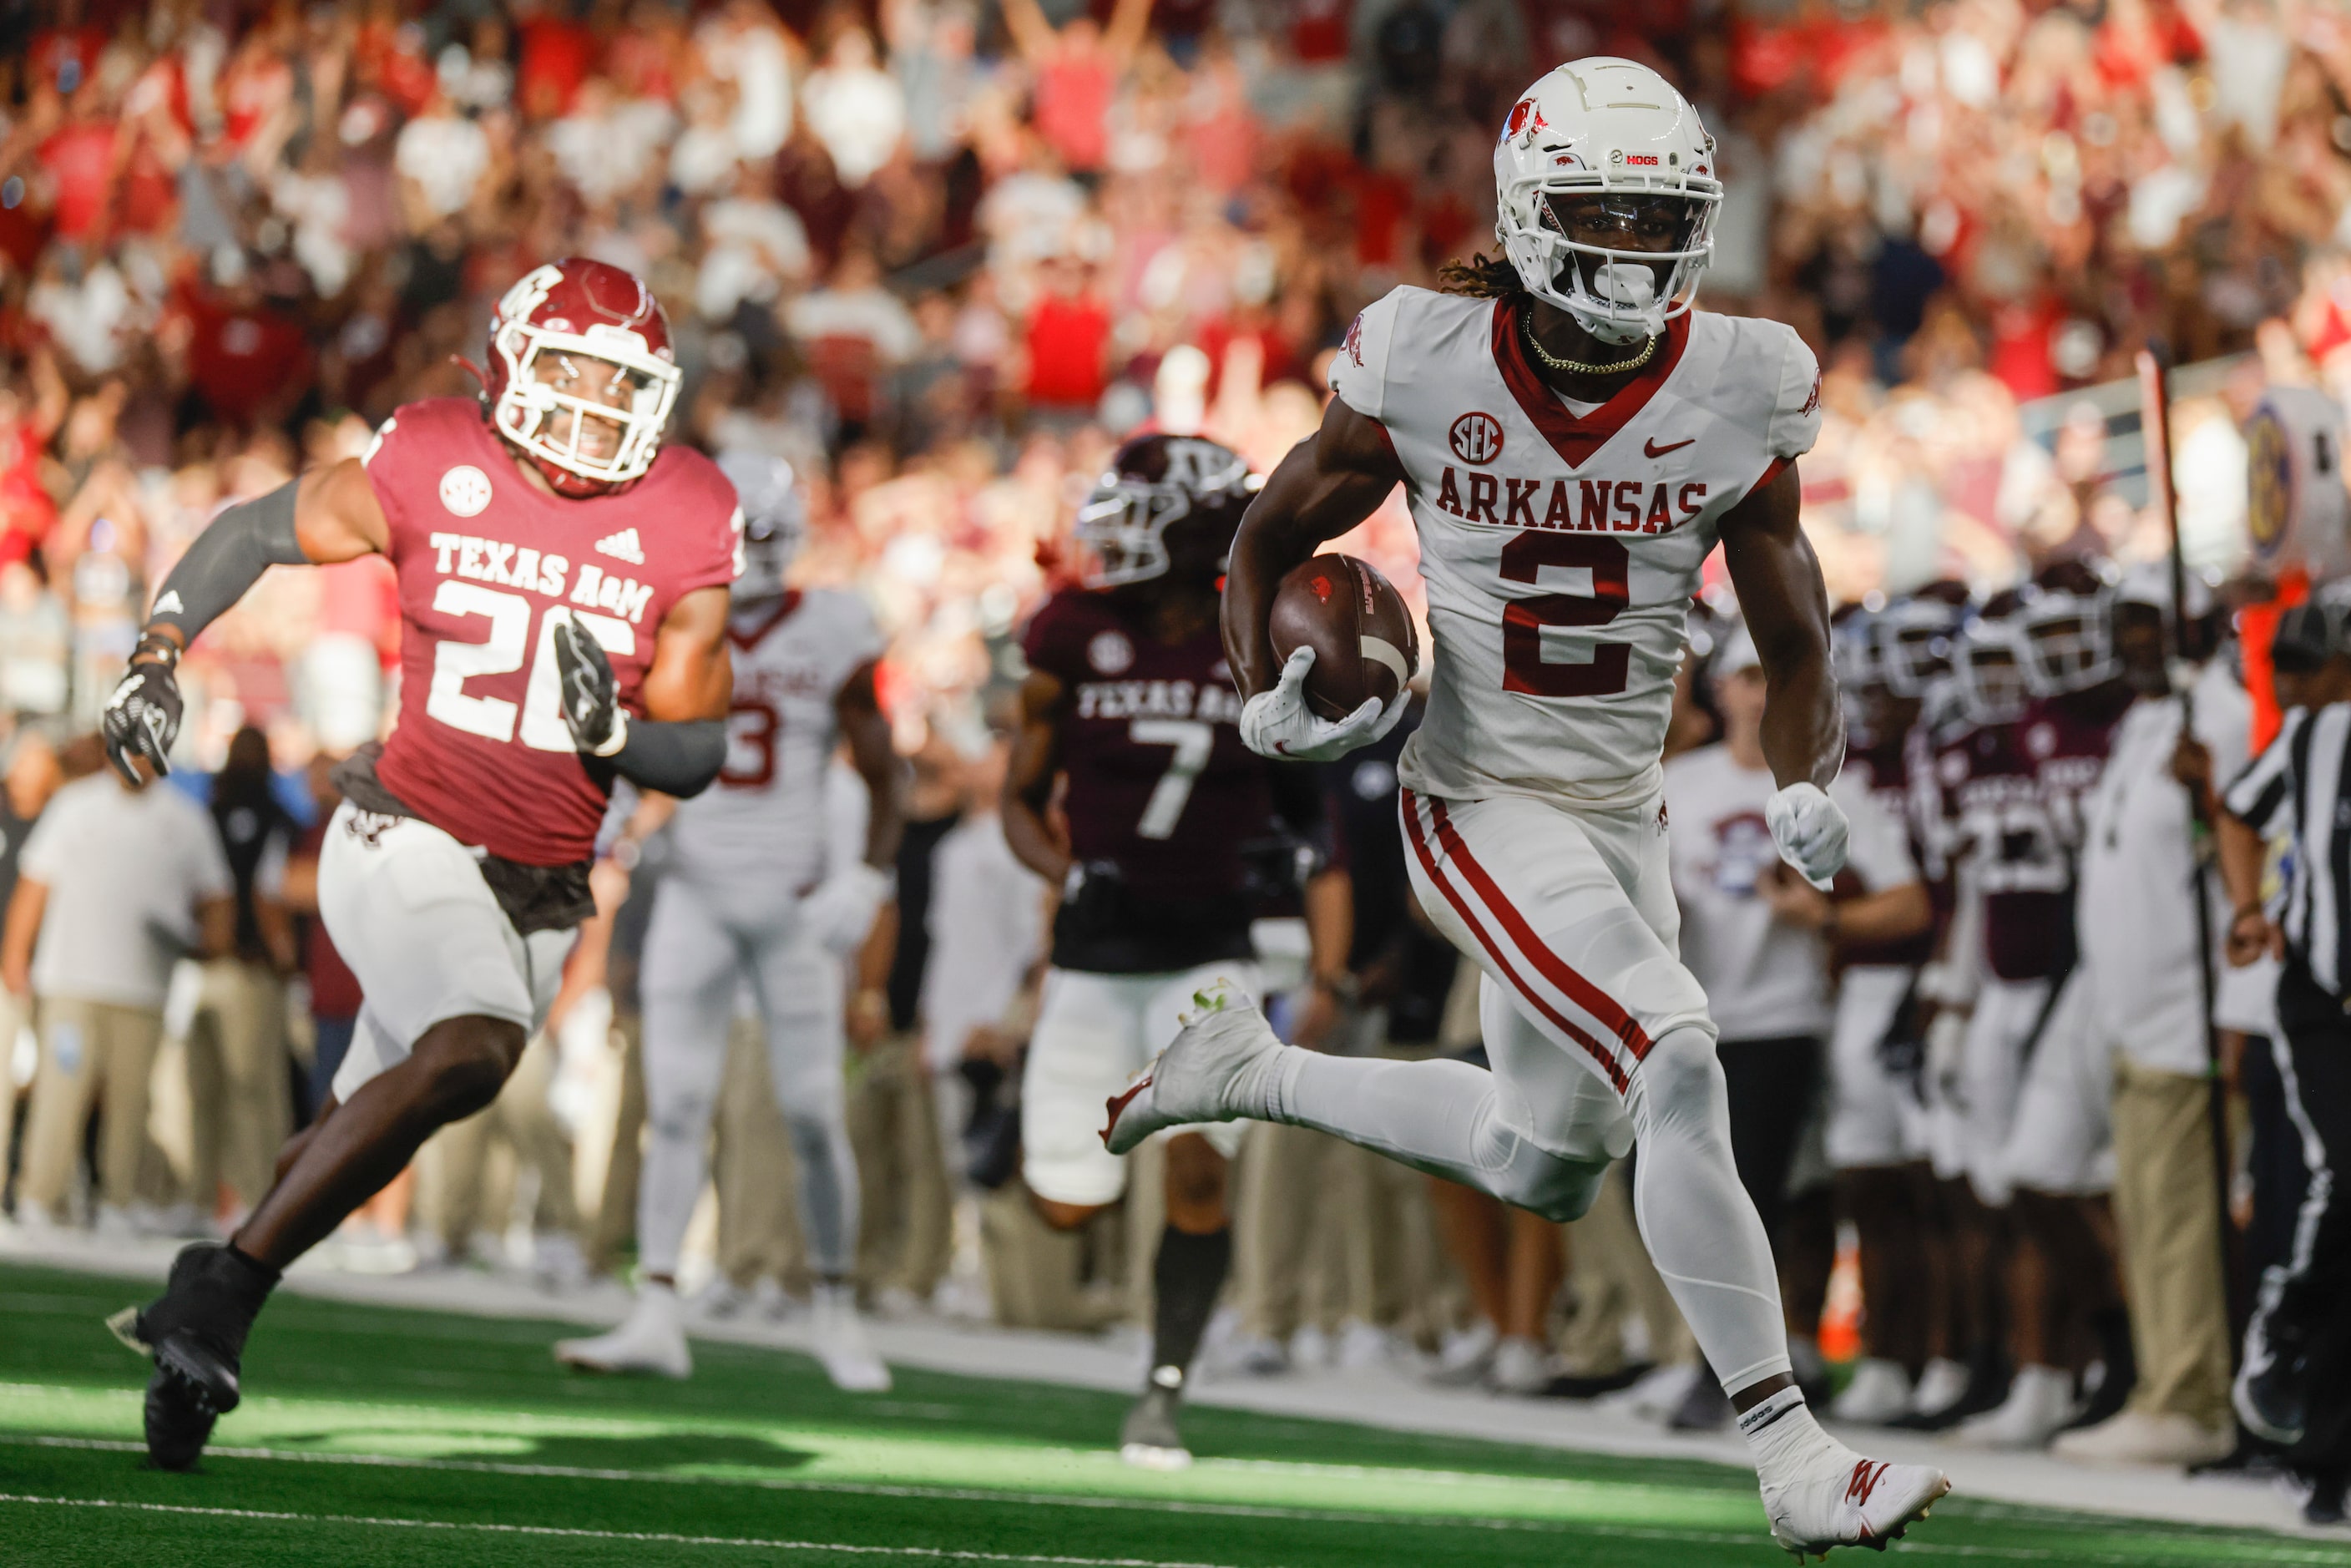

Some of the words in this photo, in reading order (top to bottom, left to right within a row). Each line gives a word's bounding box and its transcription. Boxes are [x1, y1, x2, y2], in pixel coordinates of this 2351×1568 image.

[1626, 155, 1658, 165] HOGS
[1454, 415, 1499, 462] SEC
[1436, 466, 1706, 534] ARKANSAS
[430, 532, 569, 597] TEXAS
[1499, 529, 1631, 697] 2
[1077, 680, 1195, 719] TEXAS
[1129, 720, 1213, 839] 7
